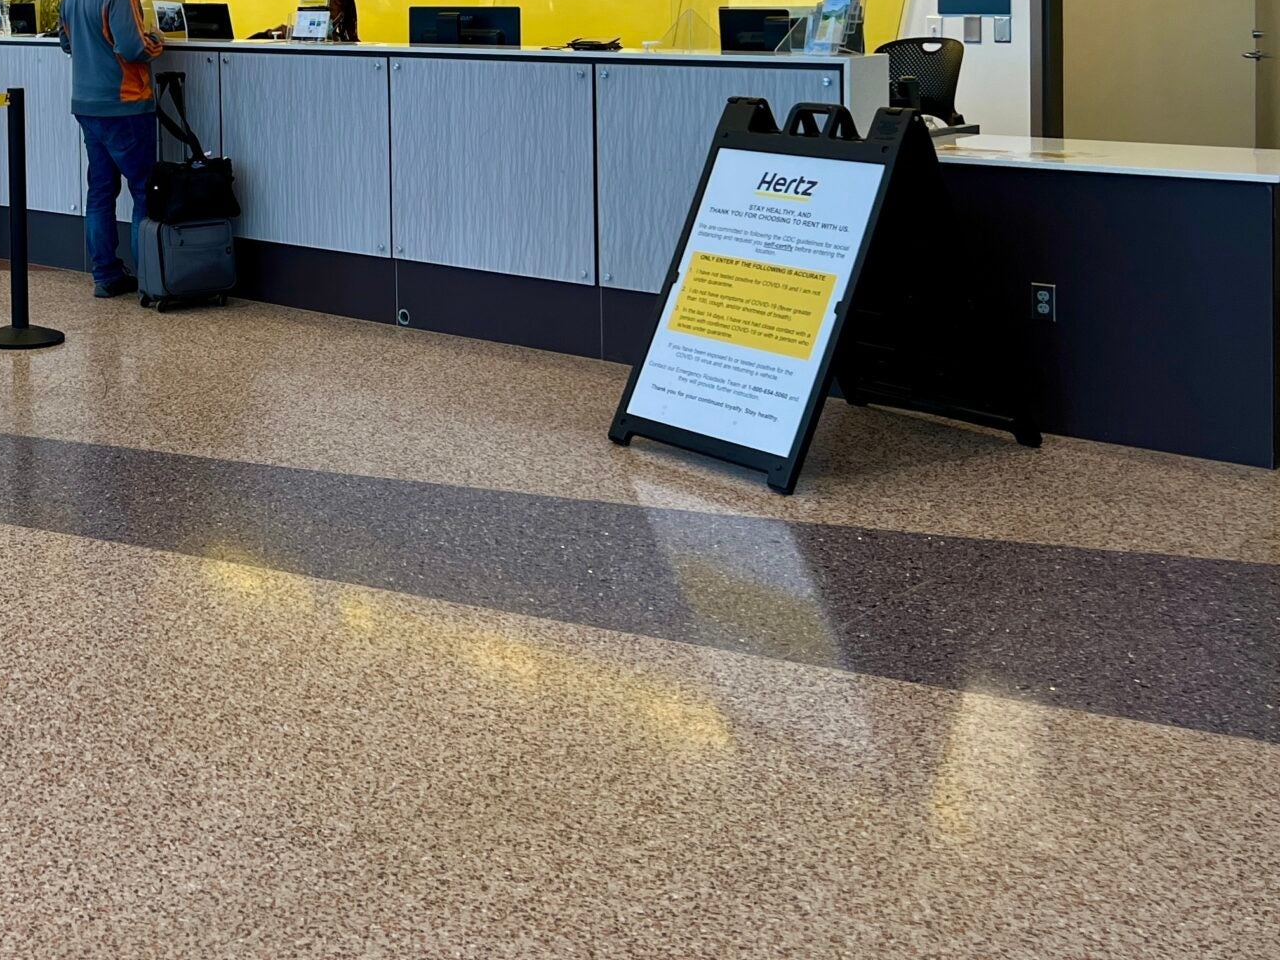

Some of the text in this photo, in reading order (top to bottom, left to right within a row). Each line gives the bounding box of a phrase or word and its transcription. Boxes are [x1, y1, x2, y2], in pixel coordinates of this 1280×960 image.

[756, 172, 819, 197] Hertz
[757, 214, 791, 223] CHOOSING
[715, 257, 733, 265] ENTER
[751, 263, 786, 274] FOLLOWING
[793, 270, 826, 281] ACCURATE
